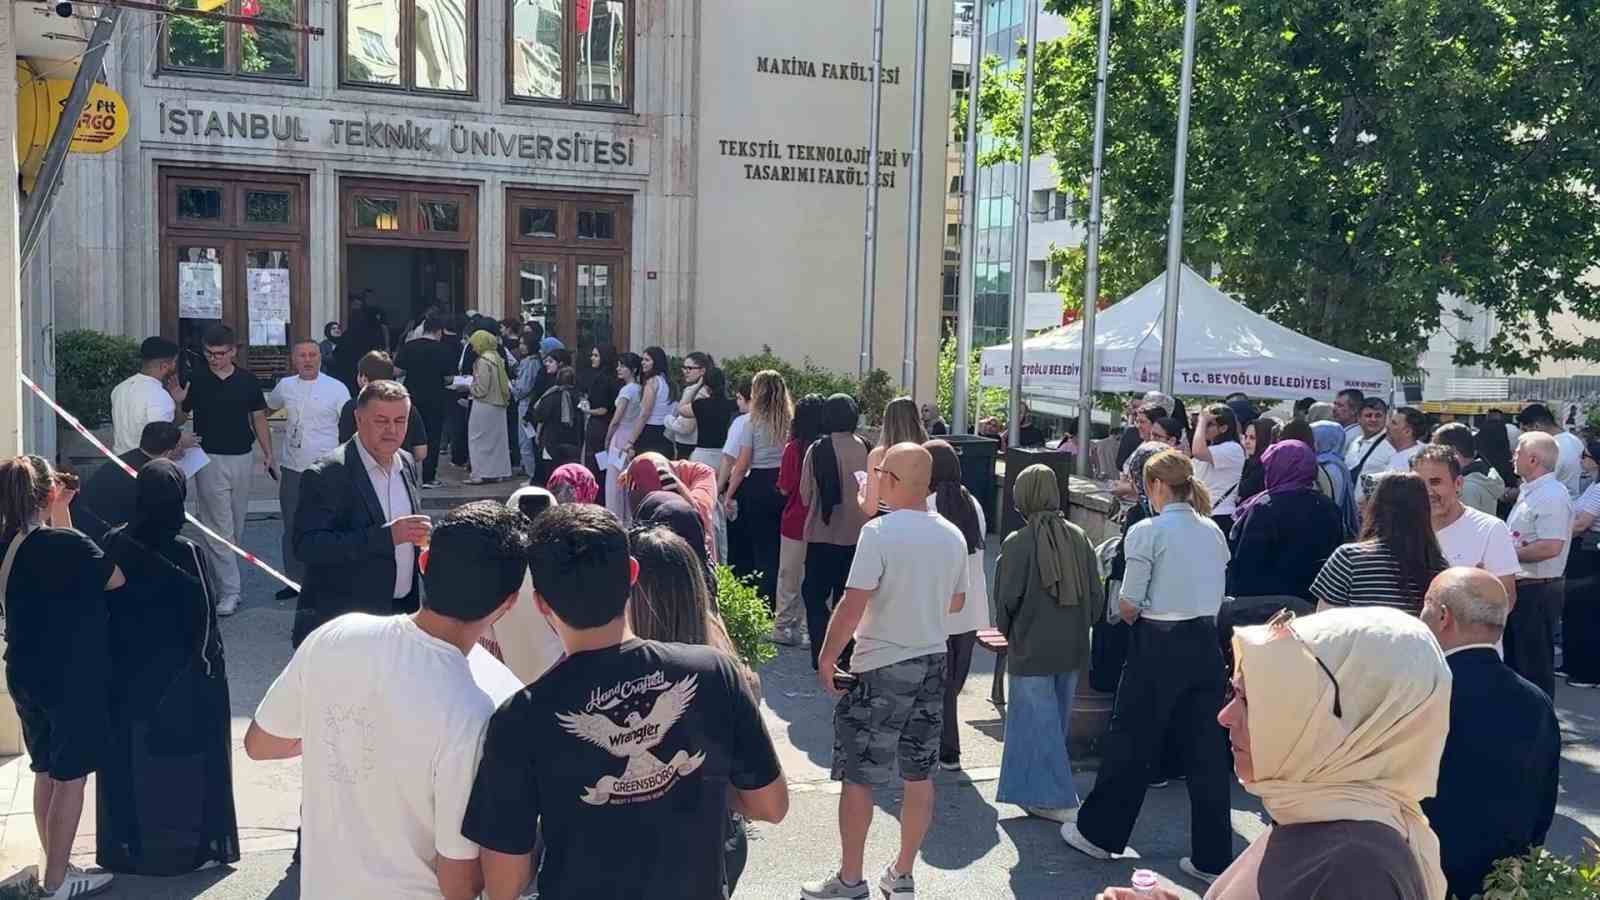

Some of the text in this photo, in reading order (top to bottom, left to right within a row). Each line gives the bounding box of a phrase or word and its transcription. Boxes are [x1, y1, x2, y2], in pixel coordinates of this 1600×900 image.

[757, 56, 817, 78] MAKİNA
[159, 102, 634, 167] İSTANBUL TEKNİK ÜNİVERSİTESİ
[719, 140, 782, 159] TEKSTİL
[744, 164, 815, 183] TASARIMI
[1182, 372, 1331, 390] T.C. BEYOĞLU BELEDİYESİ
[586, 670, 667, 712] Hand Crafted
[609, 722, 660, 746] Wrangler
[613, 765, 674, 793] GREENSBORO
